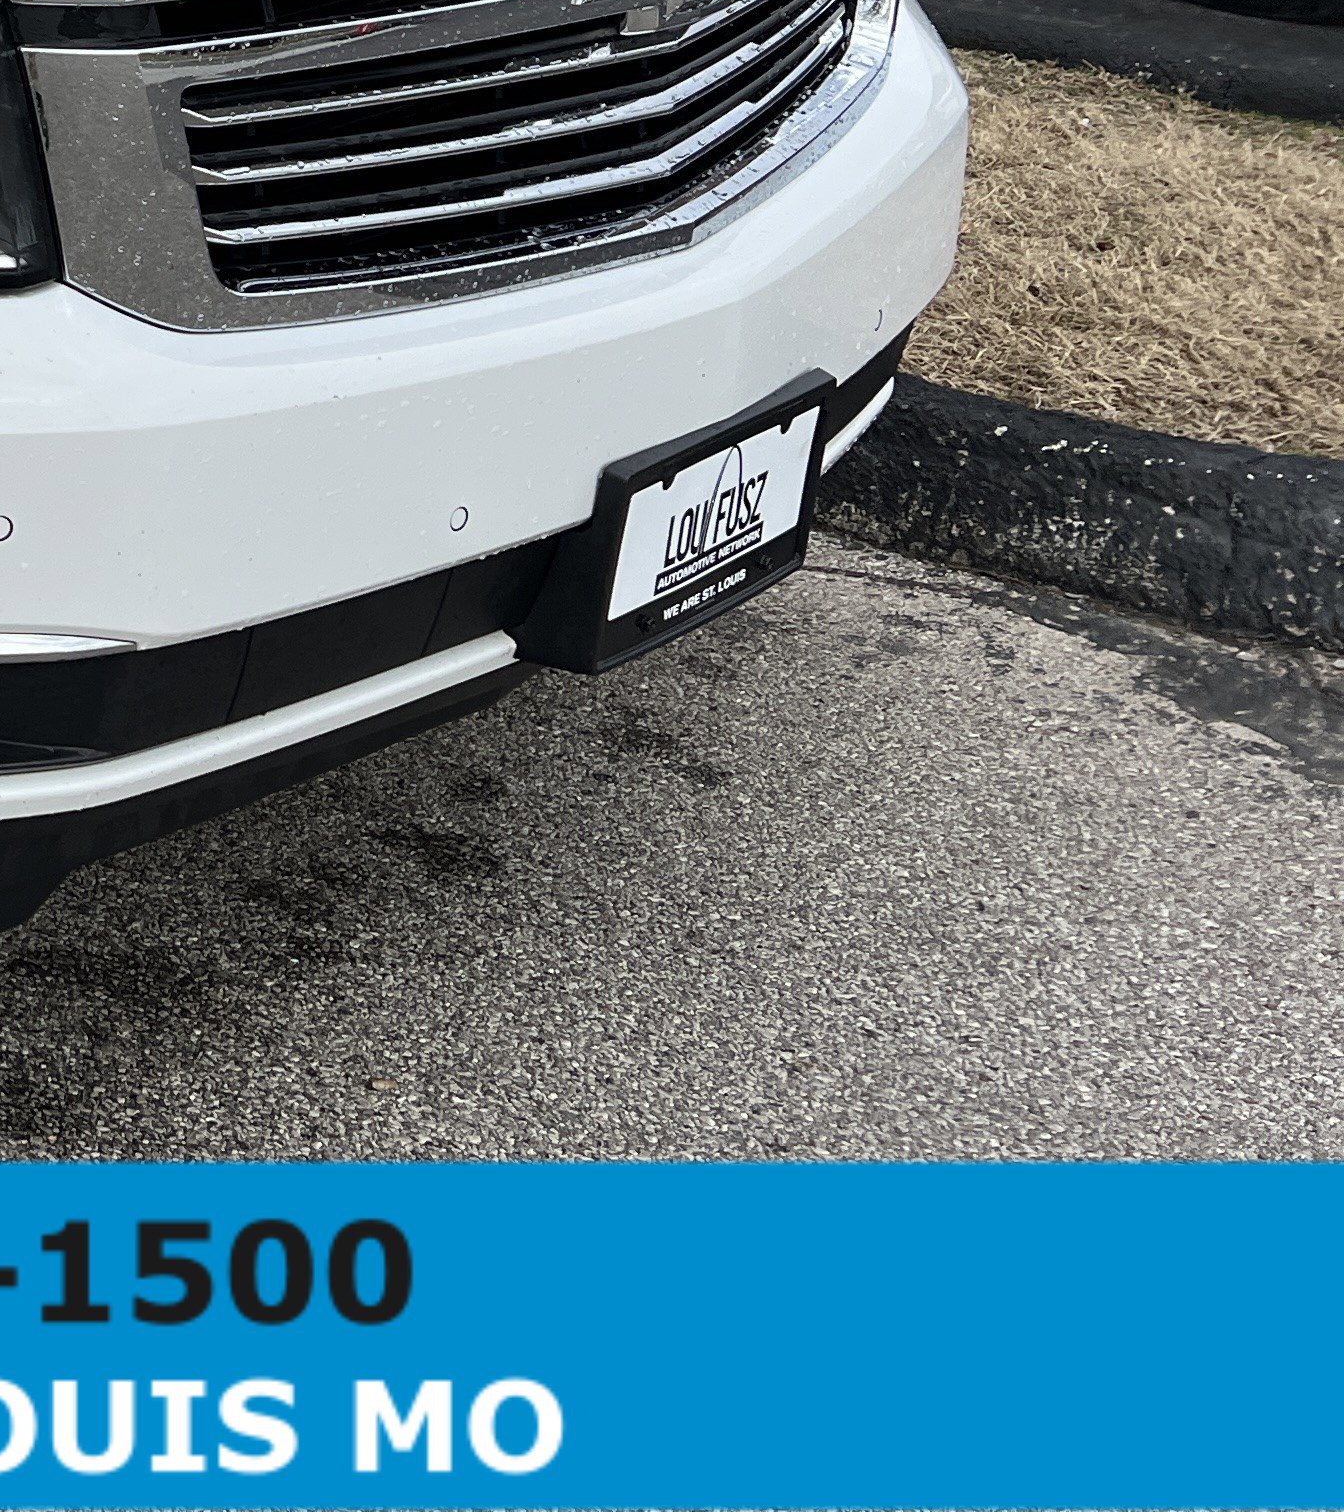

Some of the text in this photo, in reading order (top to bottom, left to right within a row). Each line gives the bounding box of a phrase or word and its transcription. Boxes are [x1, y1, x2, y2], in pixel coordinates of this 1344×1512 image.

[664, 470, 769, 568] LOU FUSZ
[657, 527, 761, 590] AUTOMOTIVE NETWORK
[663, 568, 747, 620] WE ARE ST. LOUIS
